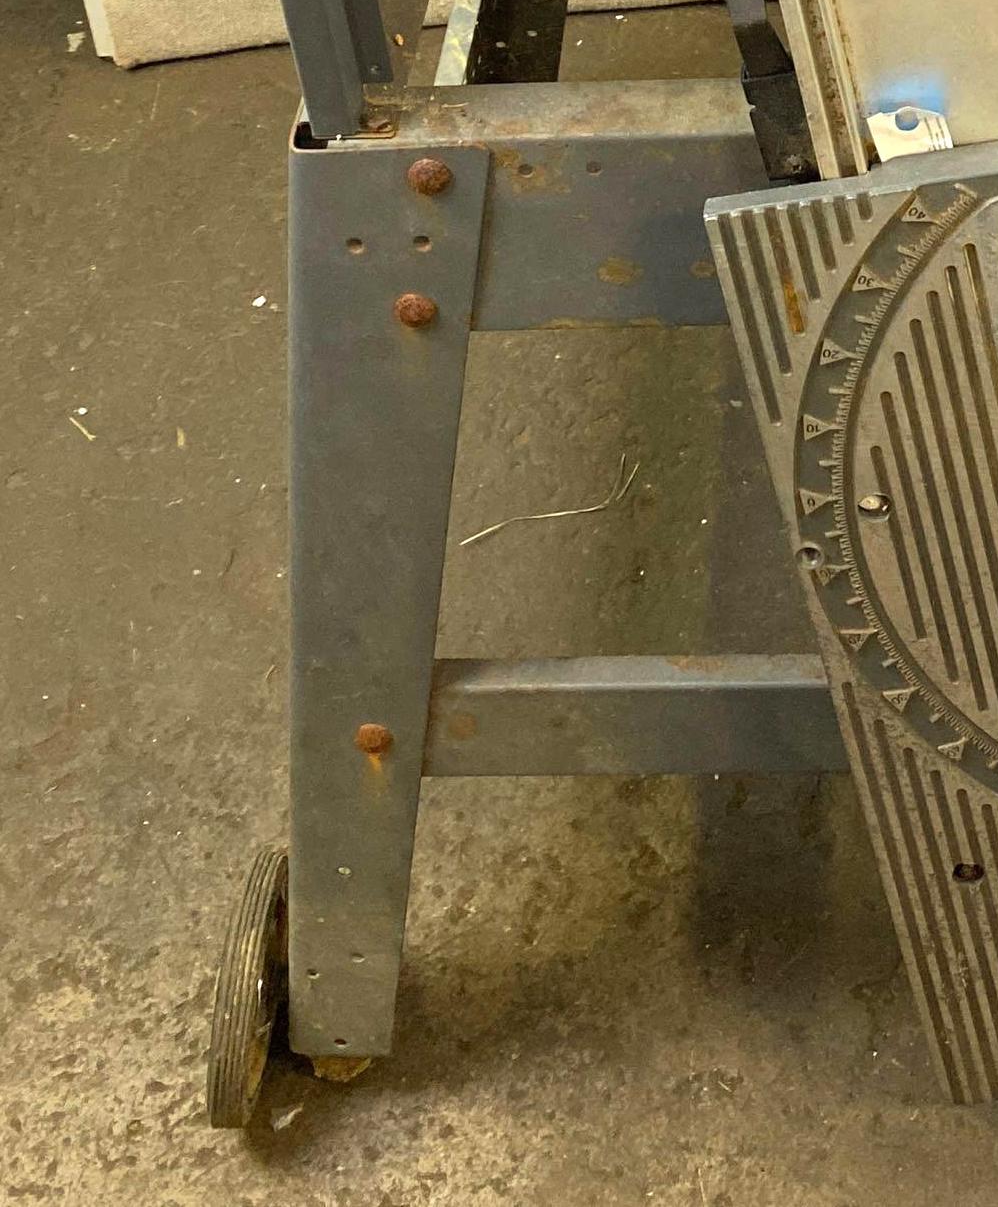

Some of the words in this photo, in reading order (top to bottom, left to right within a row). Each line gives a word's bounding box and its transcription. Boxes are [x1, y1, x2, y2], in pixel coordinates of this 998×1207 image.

[907, 207, 926, 219] 40
[856, 275, 875, 287] 30
[822, 348, 839, 359] 20
[806, 423, 820, 433] 10
